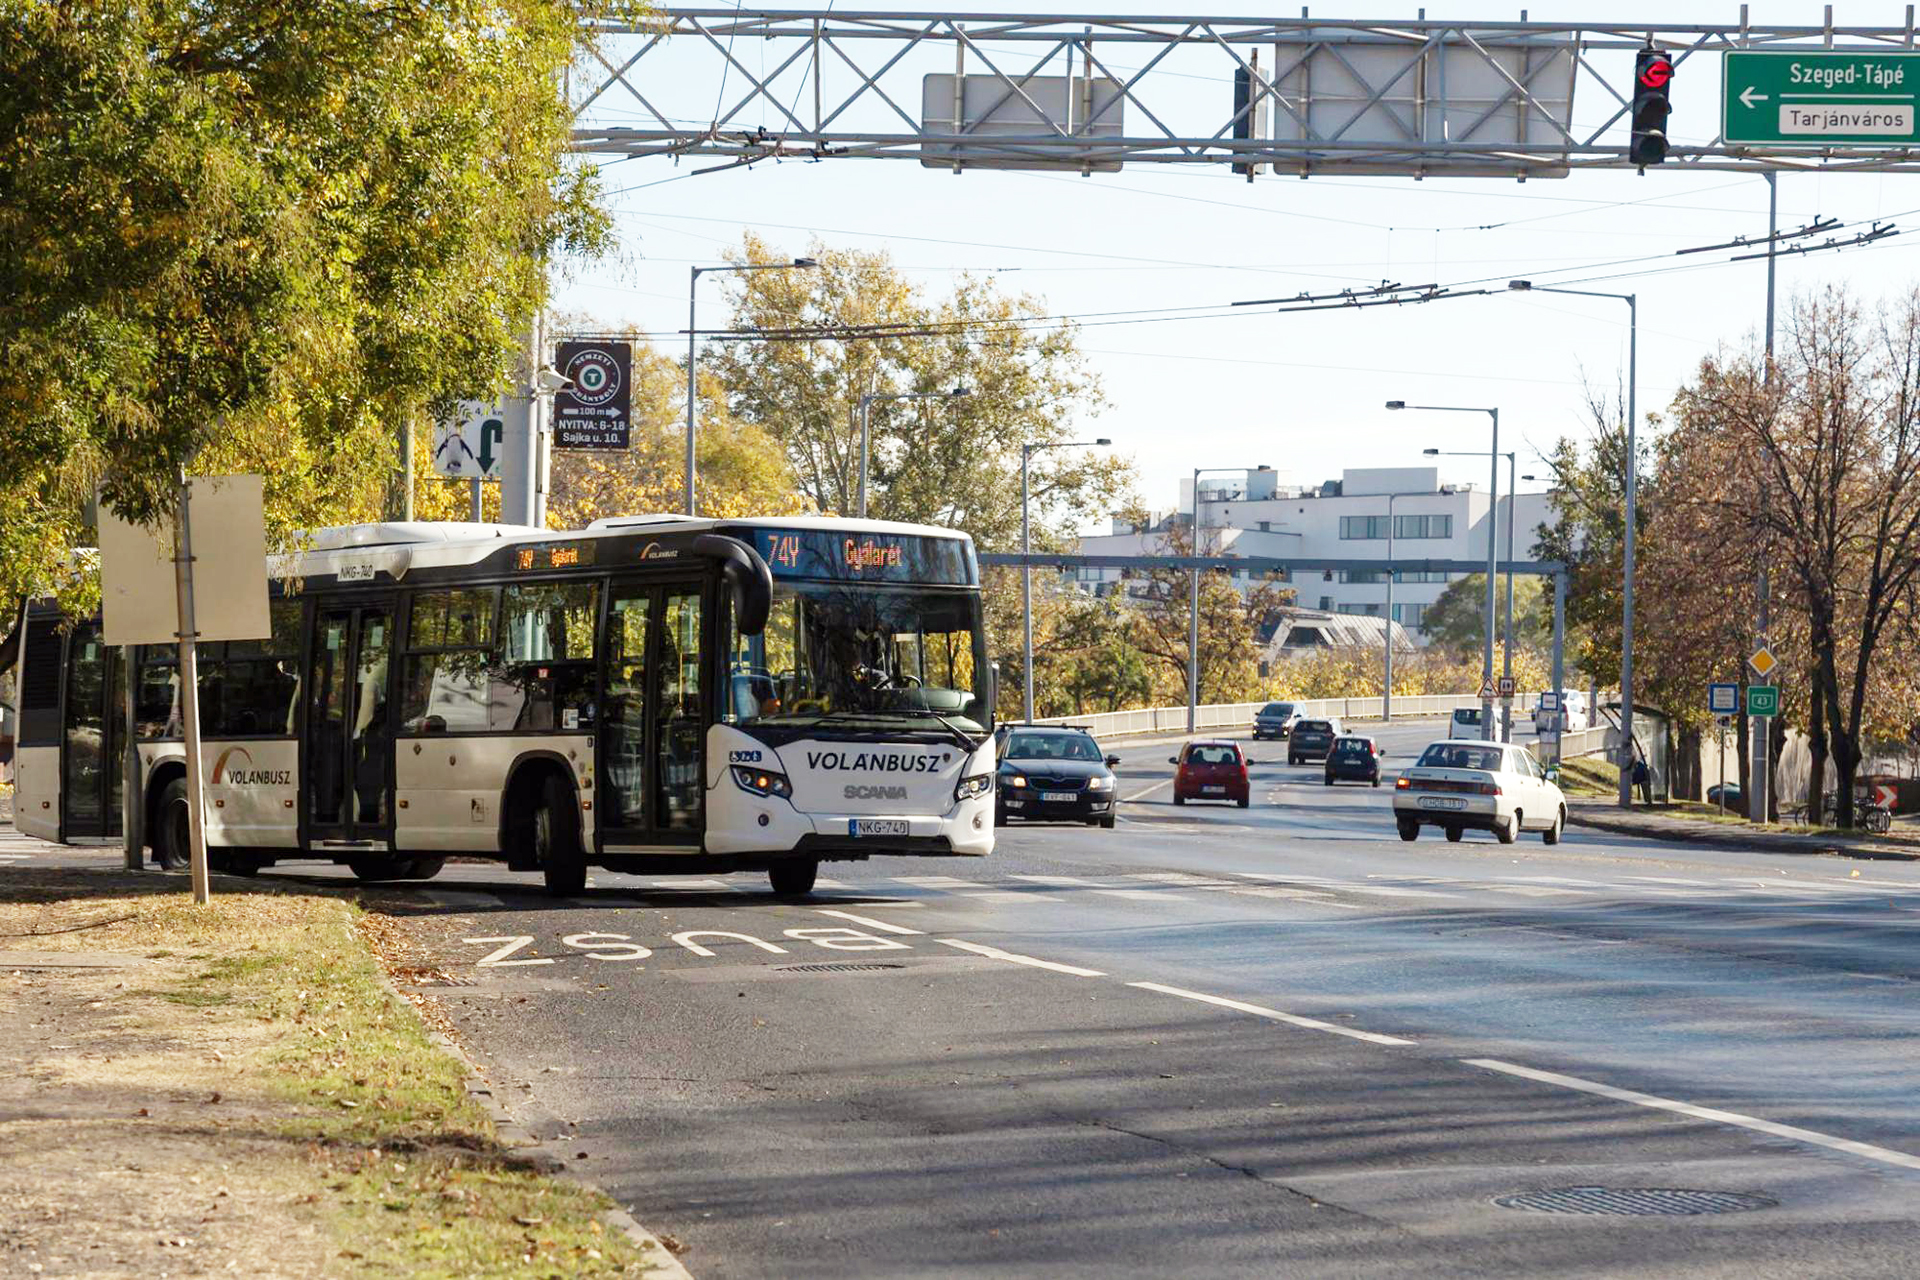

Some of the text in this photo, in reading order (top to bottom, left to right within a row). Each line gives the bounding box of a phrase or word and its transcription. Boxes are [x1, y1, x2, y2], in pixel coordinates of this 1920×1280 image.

[1790, 63, 1904, 89] Szeged-Tápé
[1790, 110, 1904, 130] Tarjánváros
[574, 353, 612, 366] NEMZETI
[572, 382, 617, 402] OHÁNYBOLT
[579, 407, 596, 416] 100
[559, 420, 625, 431] NYITVA: 6-18
[562, 432, 591, 444] Sajka
[593, 434, 602, 443] u.
[768, 535, 903, 571] 74Y Gyálarét
[340, 564, 373, 579] NKG-740
[807, 751, 940, 773] VOLÁNBUSZ
[228, 769, 291, 785] VOLÁNBUSZ
[844, 785, 908, 800] SCANIA
[858, 821, 907, 834] NKG-740
[462, 927, 916, 967] BUSZ
